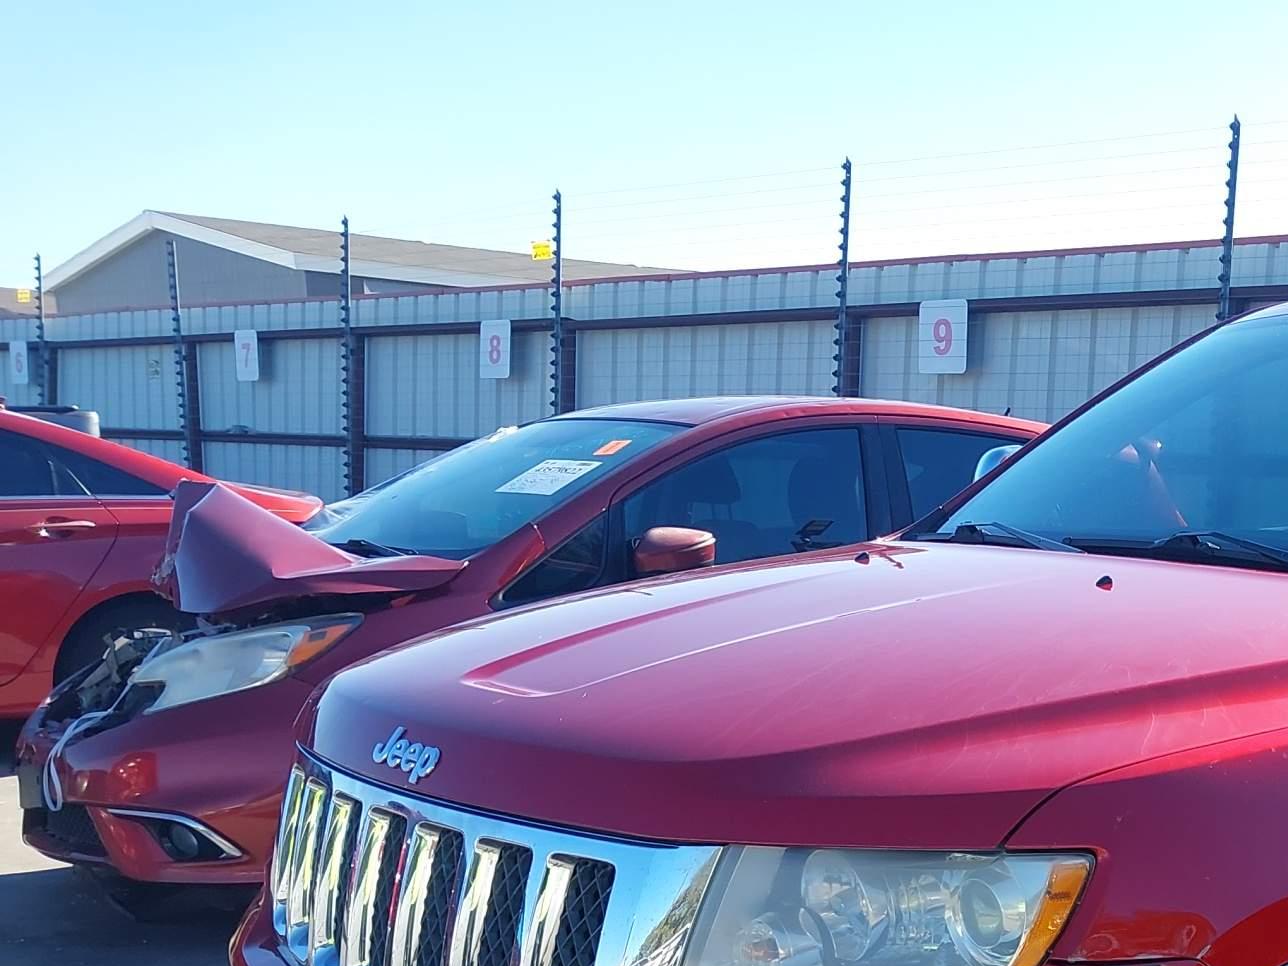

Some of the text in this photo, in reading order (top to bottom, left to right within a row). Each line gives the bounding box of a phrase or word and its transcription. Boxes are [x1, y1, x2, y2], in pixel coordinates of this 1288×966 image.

[488, 334, 501, 365] 8
[933, 318, 953, 355] 9
[240, 342, 251, 369] 7
[372, 726, 441, 785] Jeep
